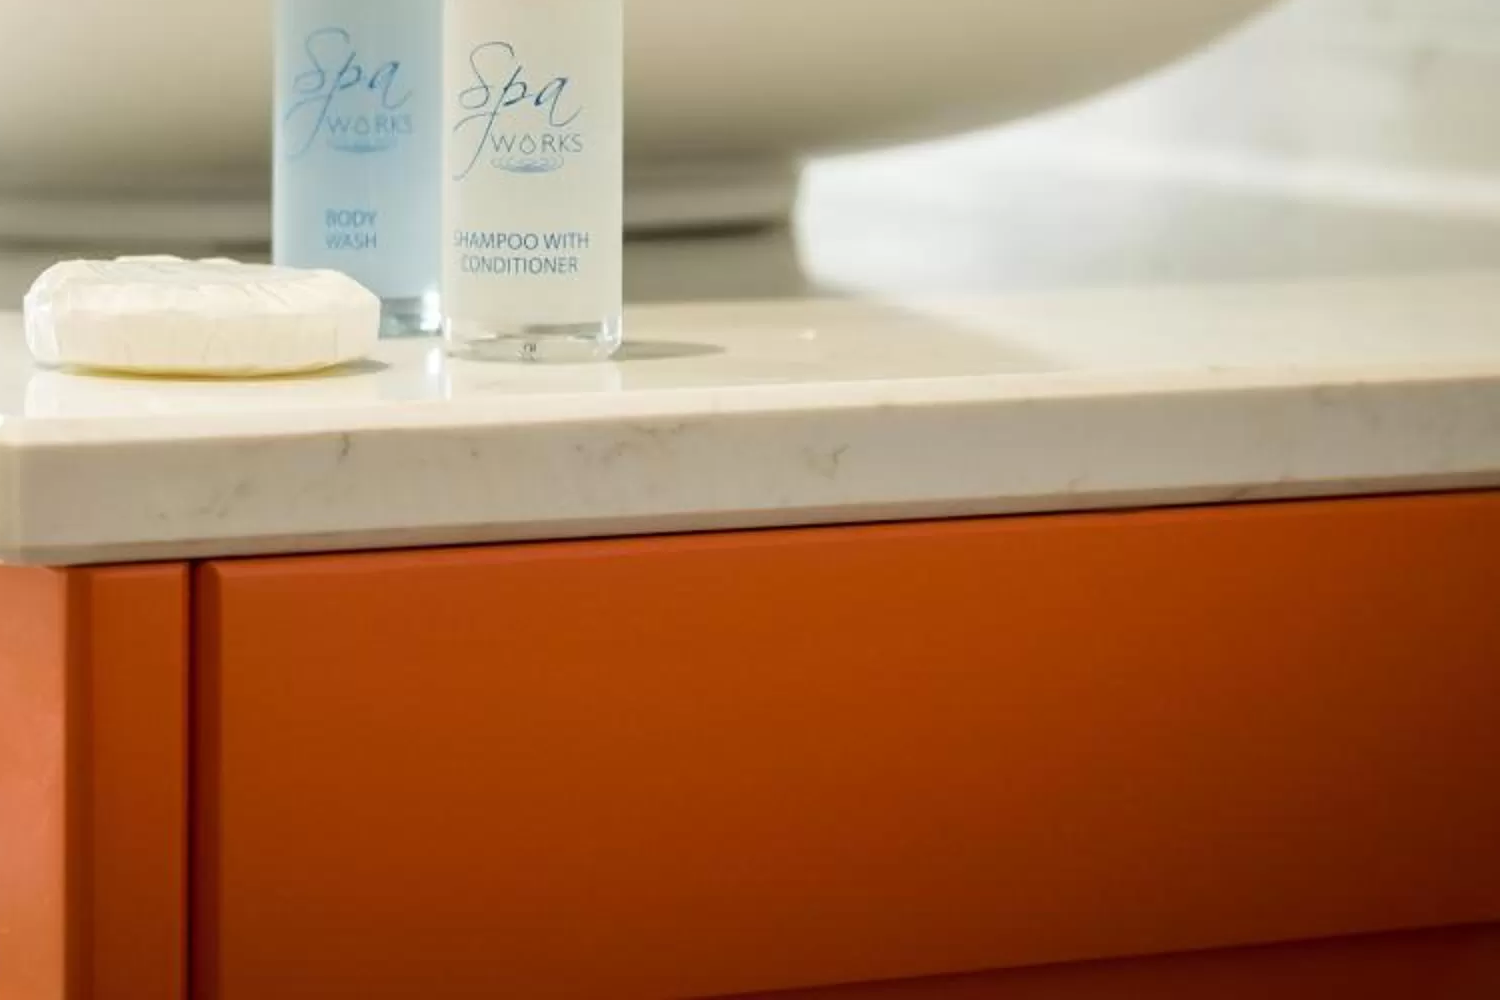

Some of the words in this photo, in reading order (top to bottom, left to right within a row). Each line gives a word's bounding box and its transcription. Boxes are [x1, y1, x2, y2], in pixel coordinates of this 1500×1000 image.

[283, 26, 413, 158] Spa
[452, 41, 583, 180] Spa
[490, 133, 583, 155] WORKS
[325, 208, 377, 228] BODY
[326, 231, 377, 249] WASH
[454, 231, 538, 250] SHAMPOO
[543, 231, 589, 249] WITH
[461, 256, 578, 274] CONDITIONER
